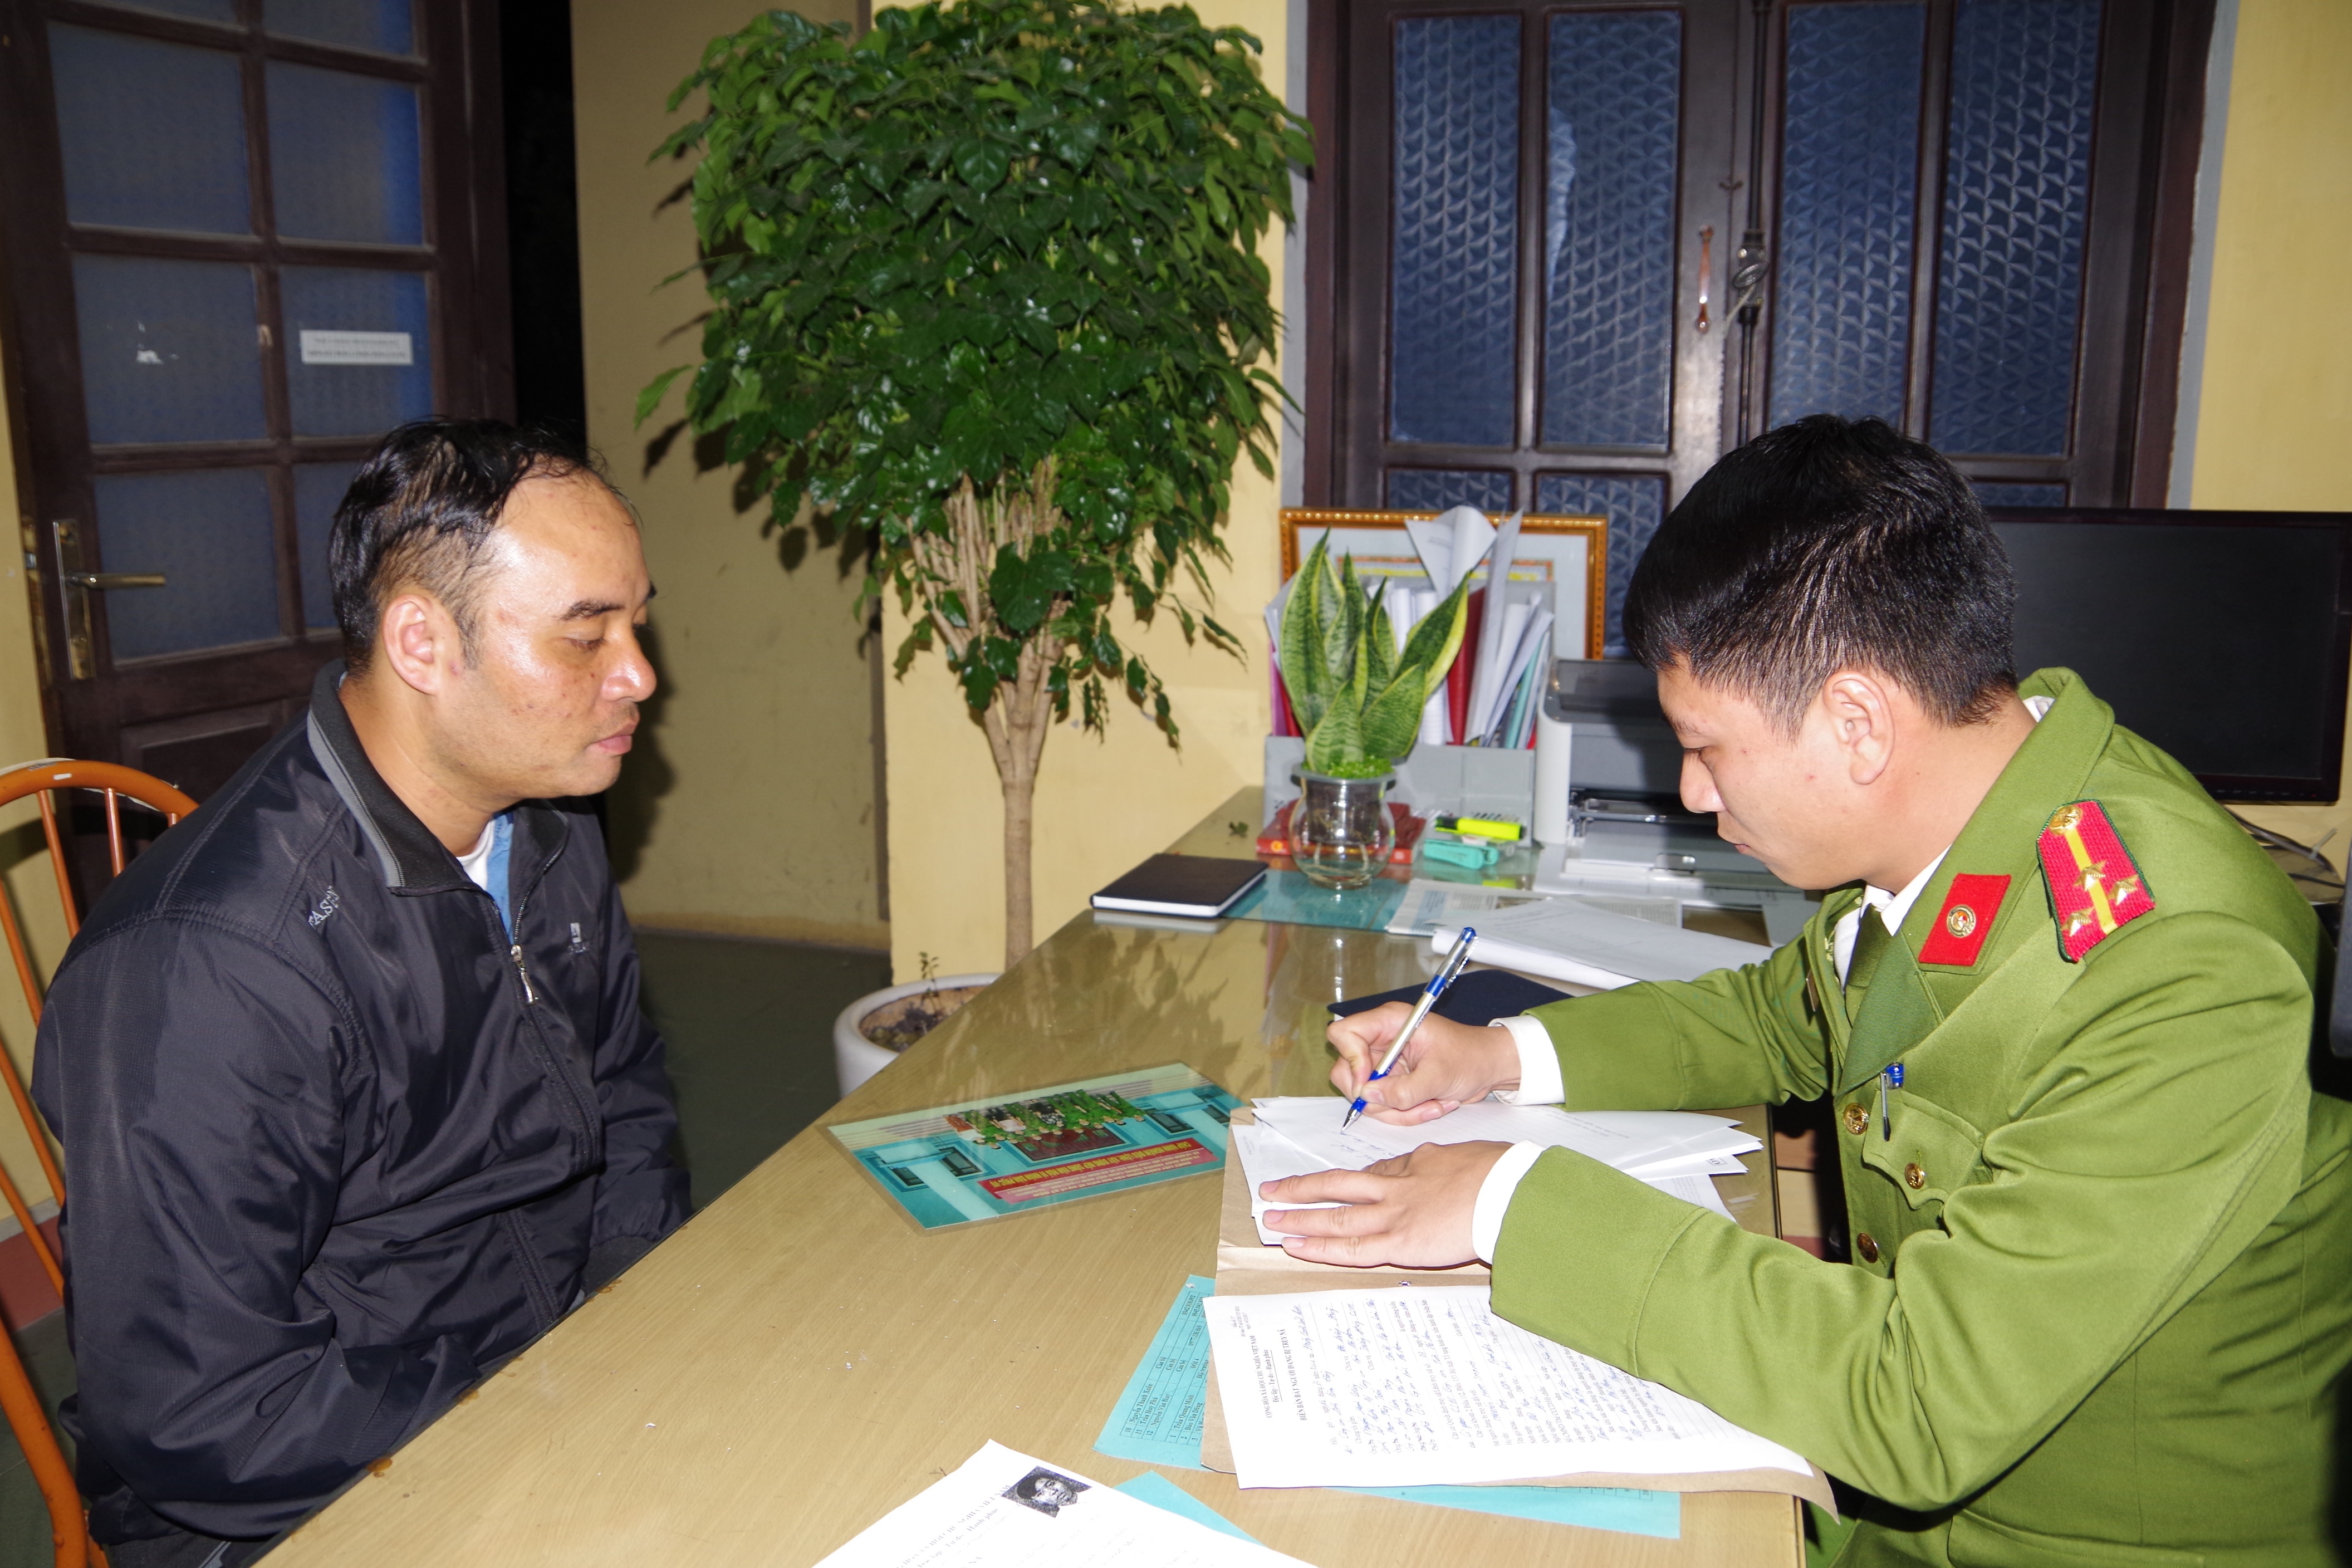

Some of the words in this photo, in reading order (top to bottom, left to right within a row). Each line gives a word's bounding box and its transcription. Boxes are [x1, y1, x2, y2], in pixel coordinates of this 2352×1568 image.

[1285, 1355, 1294, 1369] ĐANG
[1287, 1370, 1298, 1386] NGƯỜI
[1294, 1399, 1304, 1408] BẢN
[1297, 1409, 1307, 1420] BIÊN
